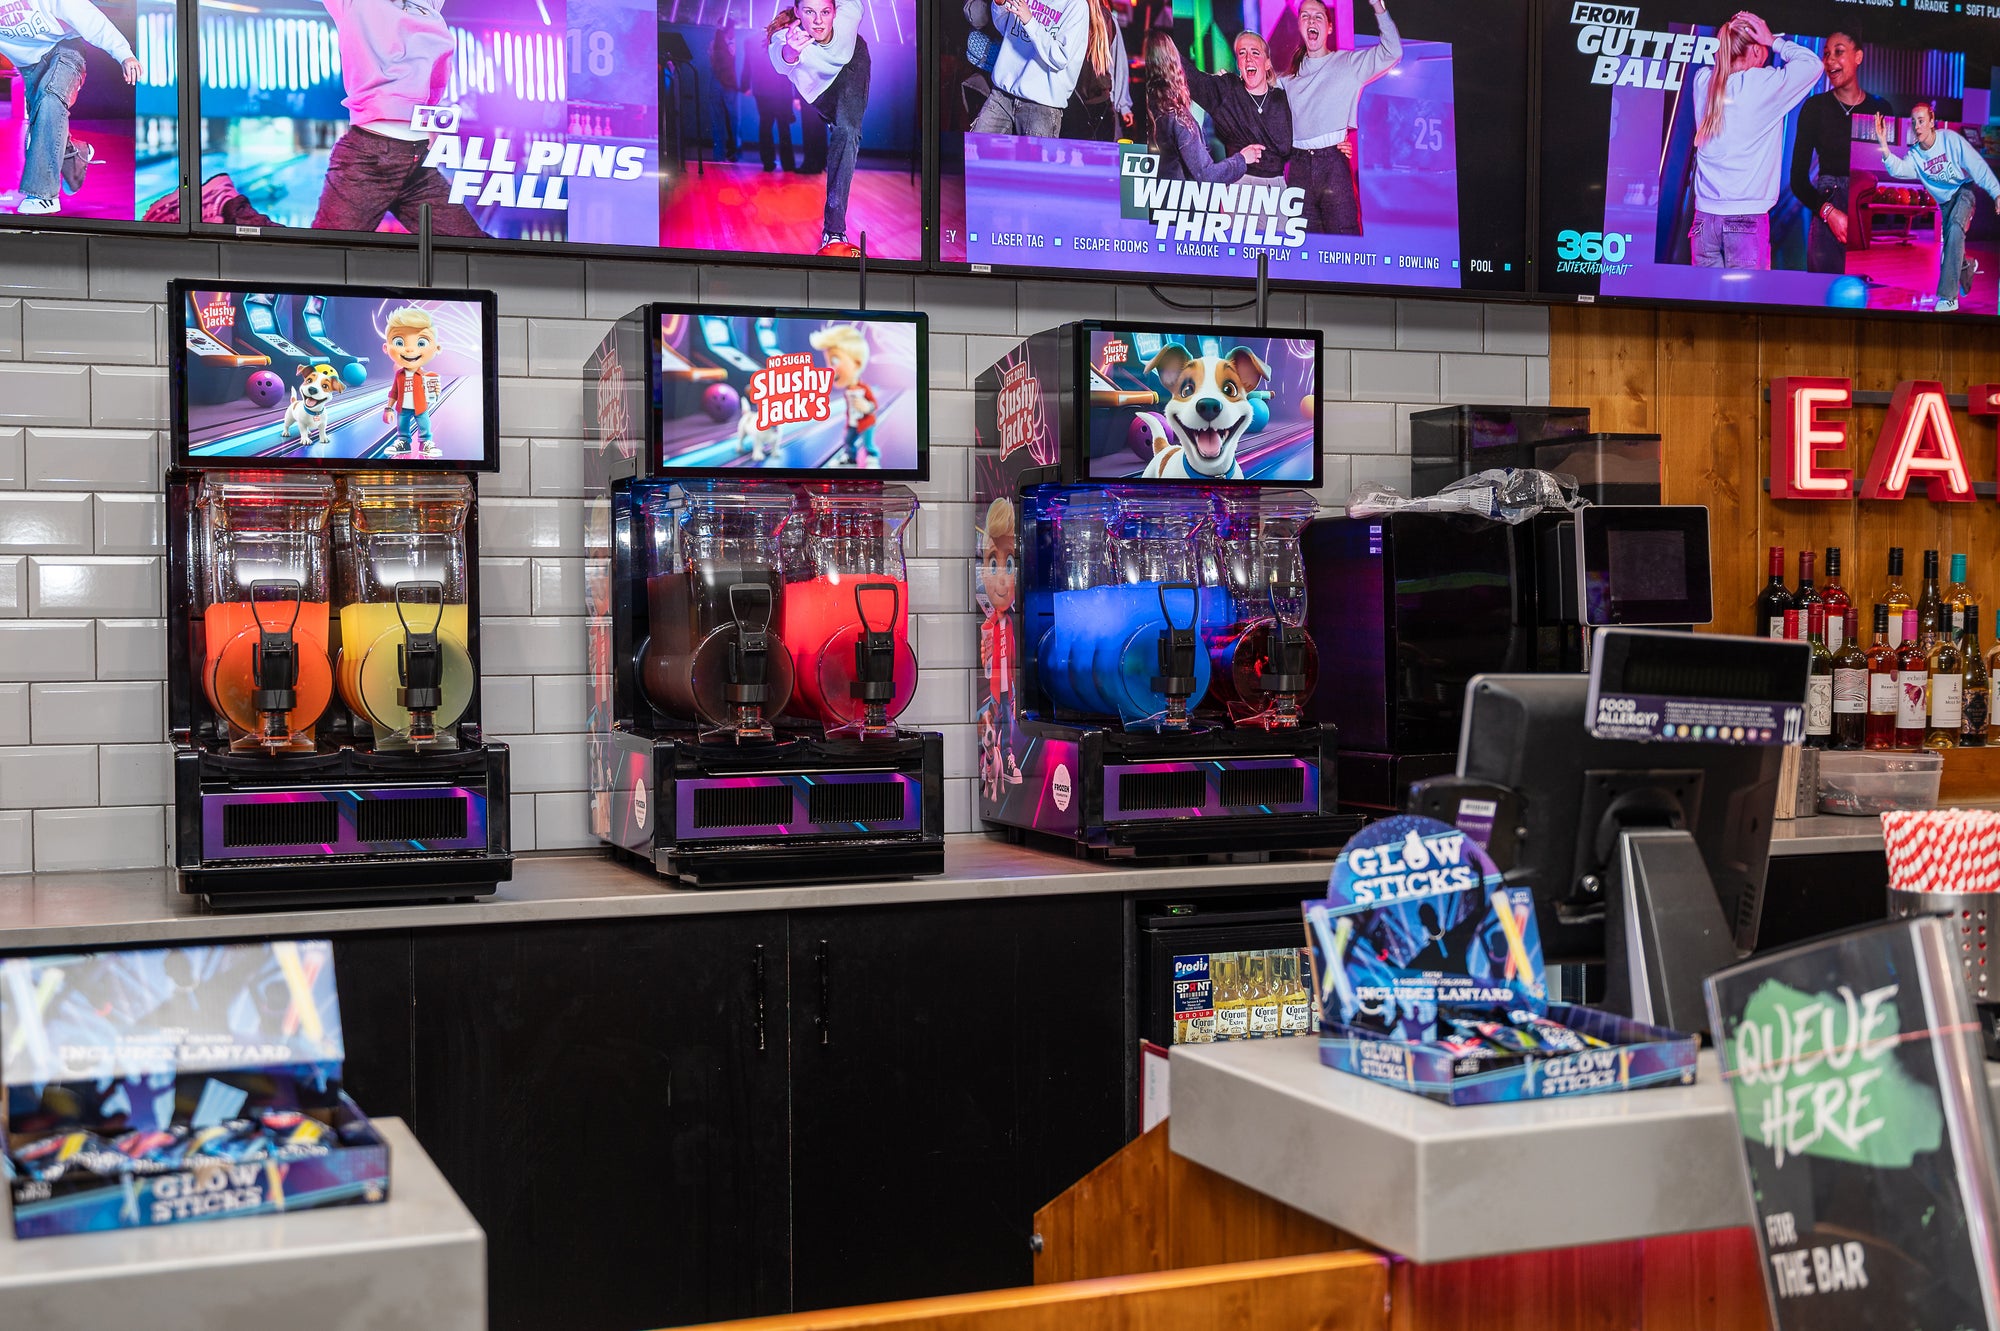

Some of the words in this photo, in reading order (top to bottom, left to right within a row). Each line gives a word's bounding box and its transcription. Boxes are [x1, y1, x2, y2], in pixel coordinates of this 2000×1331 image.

[1575, 5, 1635, 26] FROM
[1914, 0, 1949, 13] KARAOKE
[1966, 4, 1985, 17] SOFT
[567, 28, 614, 77] 18
[1577, 25, 1721, 65] GUTTER
[1591, 56, 1683, 91] BALL
[418, 108, 454, 128] TO
[1414, 117, 1442, 151] 25
[422, 135, 517, 173] ALL
[526, 140, 646, 180] PINS
[1127, 156, 1155, 174] TO
[448, 171, 569, 210] FALL
[1133, 178, 1306, 217] WINNING
[1152, 210, 1308, 247] THRILLS
[991, 232, 1023, 247] LASER
[1026, 235, 1044, 248] TAG
[1073, 237, 1110, 252] ESCAPE
[1113, 240, 1149, 254] ROOMS
[1176, 243, 1219, 258] KARAOKE
[1269, 248, 1291, 261] PLAY
[1318, 250, 1350, 265] TENPIN
[1354, 253, 1377, 267] PUTT
[1399, 255, 1440, 270] BOWLING
[1470, 259, 1494, 273] POOL
[1556, 260, 1633, 276] ENTERTAINMENT
[203, 305, 235, 319] Slushy
[1103, 344, 1128, 356] Slushy
[768, 358, 781, 369] NO
[782, 354, 811, 366] SUGAR
[753, 366, 832, 400] Slushy
[1000, 380, 1035, 425] Slushy
[1599, 698, 1636, 712] FOOD
[1597, 712, 1659, 727] ALLERGY?
[1349, 829, 1464, 877] GLOW
[1353, 866, 1471, 904] STICKS
[1175, 958, 1208, 974] Prodis
[1356, 986, 1435, 1001] INCLUDES
[1437, 987, 1514, 1002] LANYARD
[1178, 1010, 1210, 1019] GROUP
[1736, 984, 1899, 1085] QUEUE
[1360, 1040, 1402, 1063] GLOW
[1361, 1059, 1405, 1081] STICKS
[1543, 1051, 1616, 1077] GLOW
[1541, 1069, 1615, 1096] STICKS
[1760, 1067, 1886, 1169] HERE
[153, 1163, 262, 1199] GLOW
[151, 1185, 263, 1223] STICKS
[1765, 1211, 1798, 1247] FOR
[1770, 1248, 1815, 1299] THE
[1811, 1241, 1869, 1294] BAR
